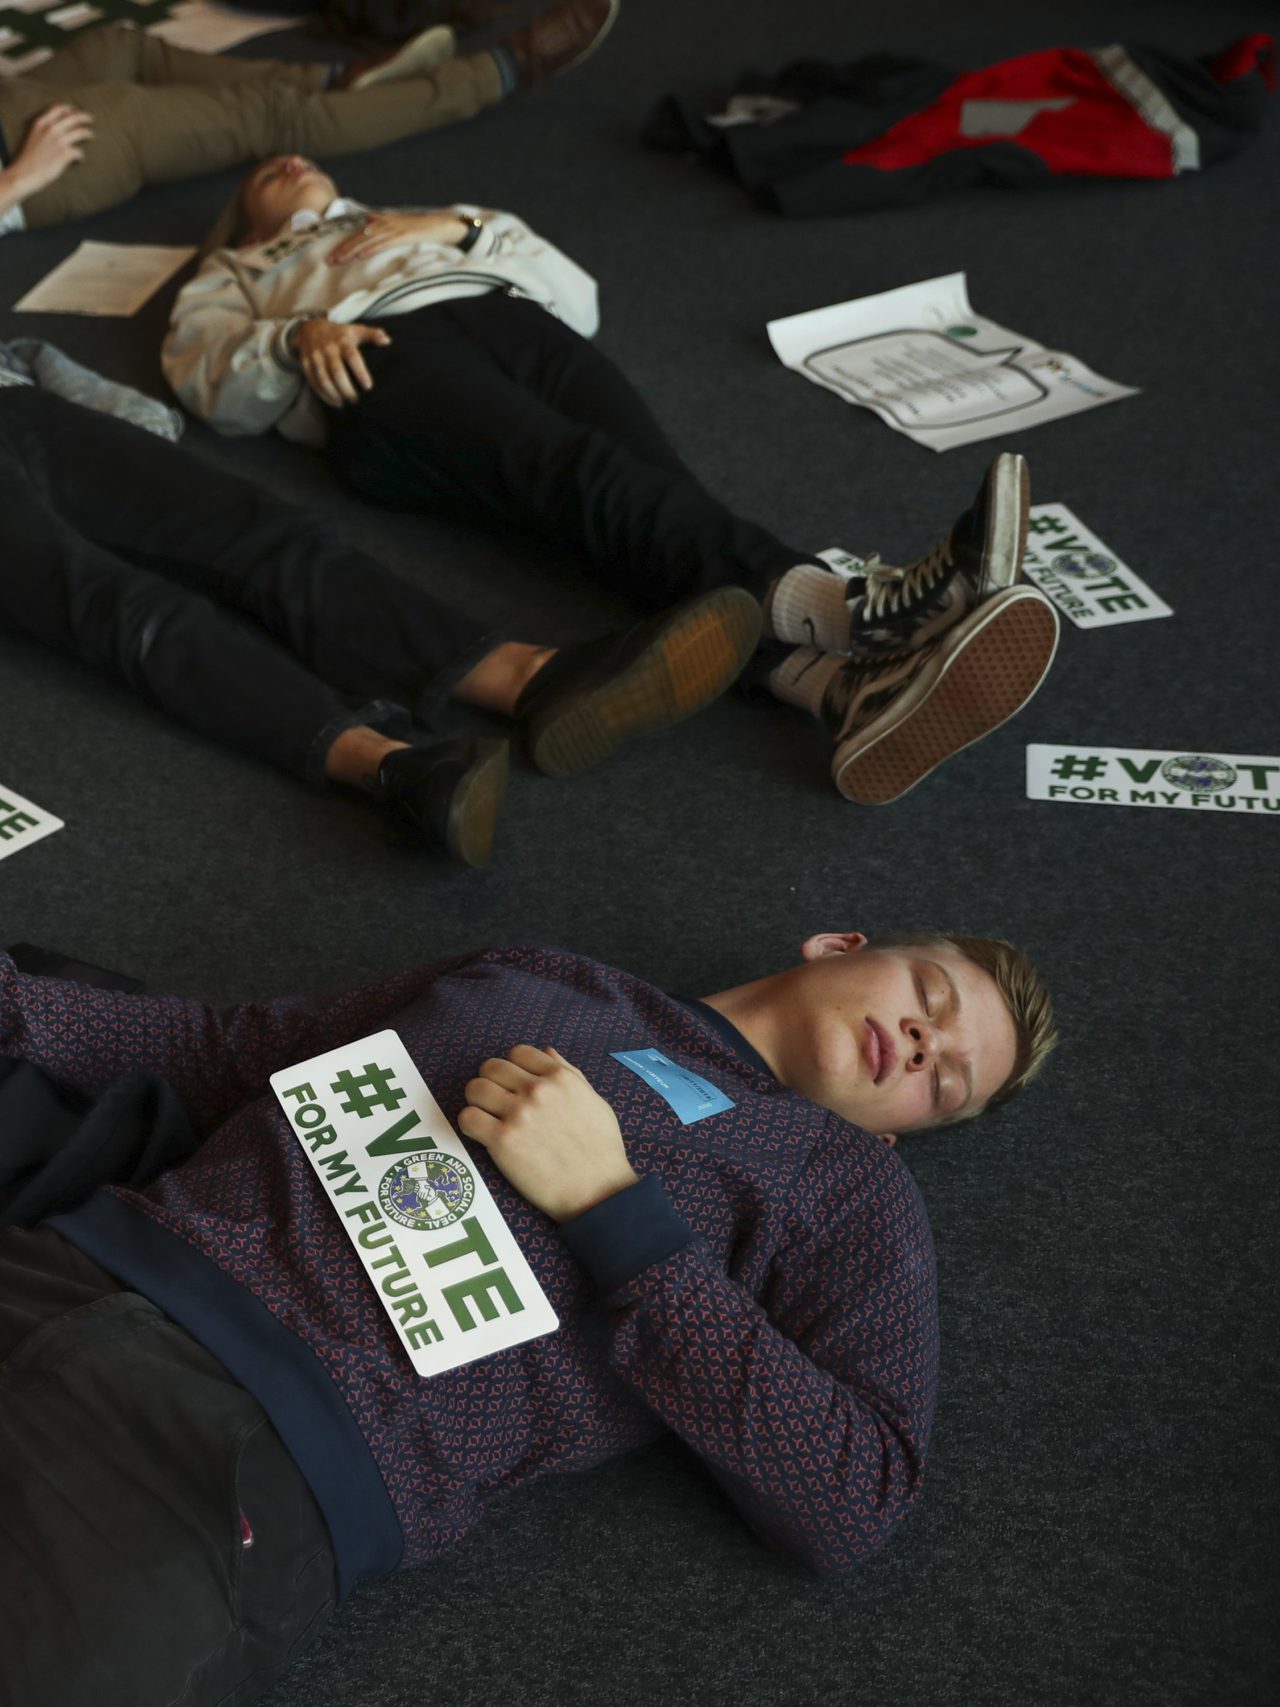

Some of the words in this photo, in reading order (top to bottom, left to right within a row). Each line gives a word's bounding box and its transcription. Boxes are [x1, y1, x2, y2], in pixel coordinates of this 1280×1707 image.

[1028, 515, 1149, 614] #VOTE
[1029, 567, 1096, 618] FUTURE
[1048, 785, 1119, 801] FOR
[1130, 790, 1180, 804] MY
[394, 1164, 402, 1172] A
[403, 1153, 445, 1166] GREEN
[445, 1157, 467, 1175] AND
[329, 1062, 525, 1332] #VOTE
[380, 1176, 392, 1196] FOR
[455, 1176, 473, 1213] SOCIAL
[282, 1081, 338, 1153] FOR
[318, 1150, 368, 1197] MY
[345, 1200, 445, 1351] FUTURE
[381, 1199, 416, 1227] FUTURE
[424, 1213, 458, 1229] DEAL
